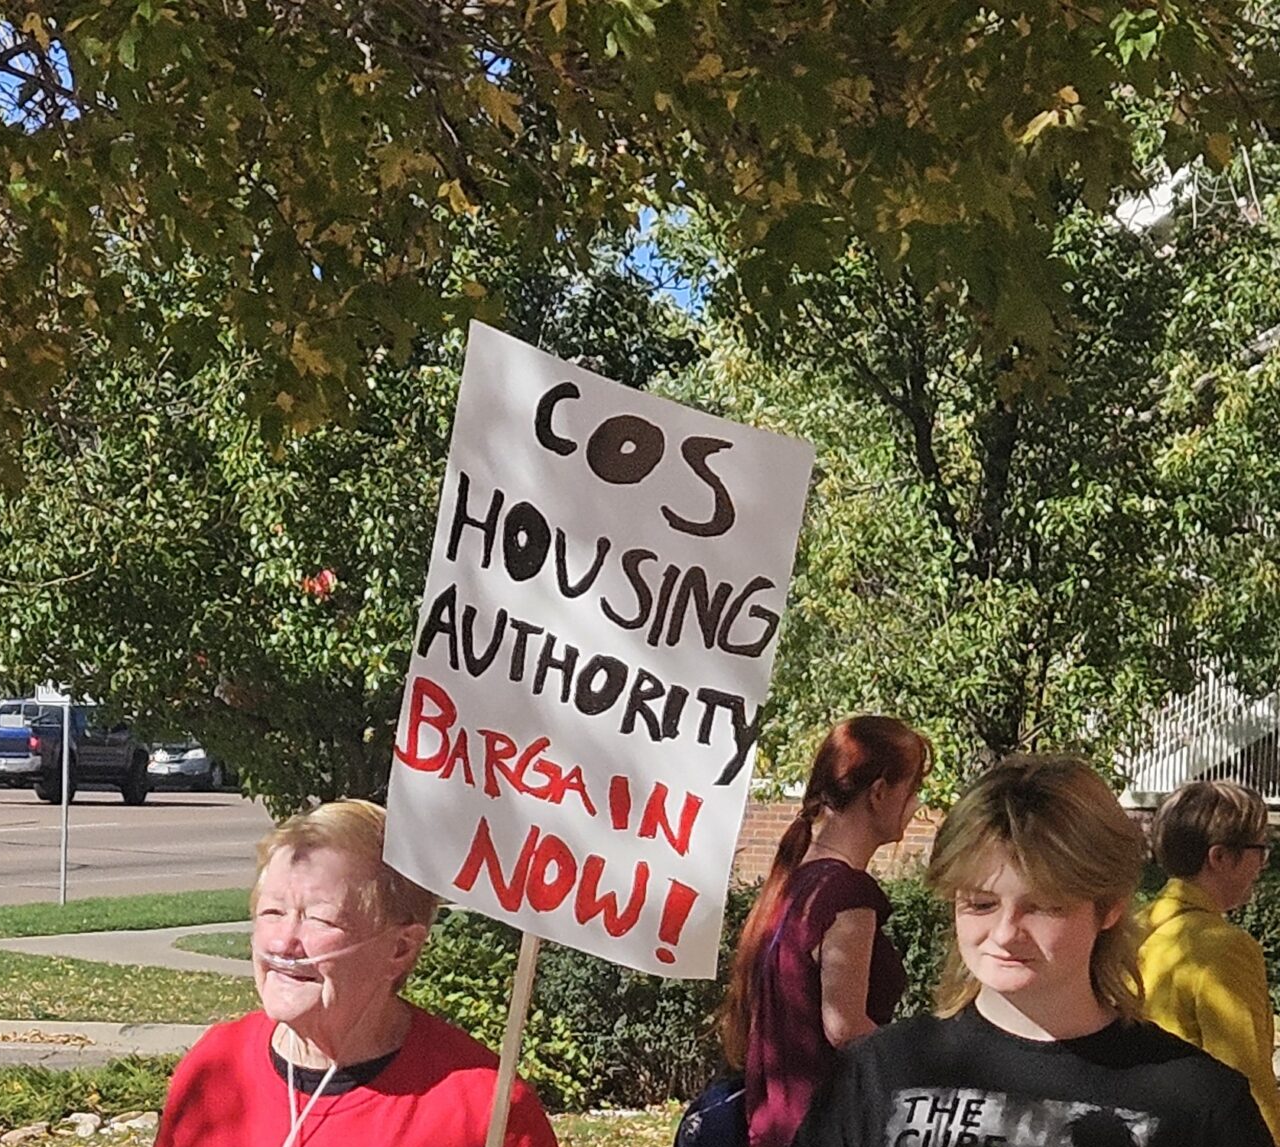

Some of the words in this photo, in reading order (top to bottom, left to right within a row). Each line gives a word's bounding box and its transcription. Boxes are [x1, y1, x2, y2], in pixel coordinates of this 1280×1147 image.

[534, 381, 735, 538] COS
[445, 471, 780, 658] HOUSING
[393, 675, 704, 856] BARGAIN
[417, 583, 766, 786] AUTHORITY
[452, 816, 700, 964] NOW!
[903, 1095, 986, 1128] THE
